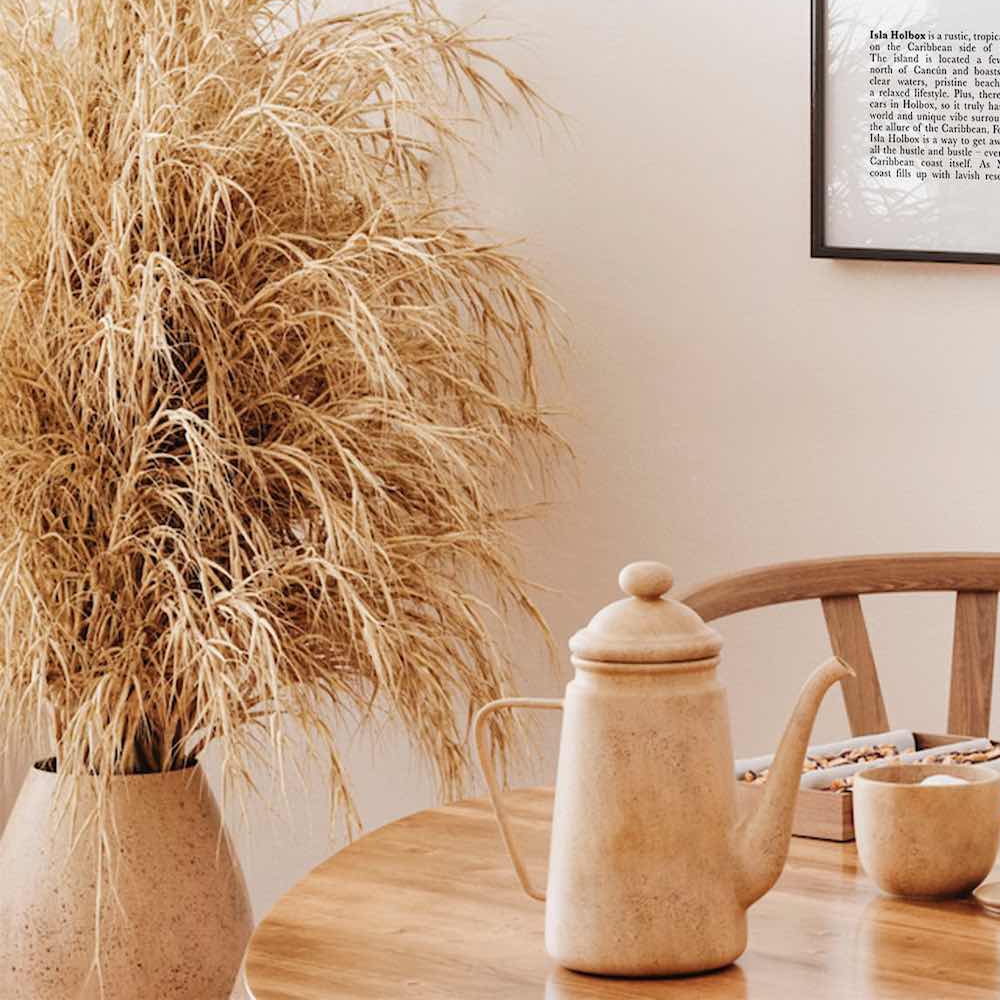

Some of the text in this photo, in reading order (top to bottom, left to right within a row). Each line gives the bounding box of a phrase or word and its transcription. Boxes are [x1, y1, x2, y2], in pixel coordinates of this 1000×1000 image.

[870, 30, 888, 39] Isla
[890, 31, 926, 40] Holbox
[928, 31, 935, 40] is
[944, 31, 972, 42] rustic,
[887, 42, 901, 51] the
[907, 42, 952, 51] Caribbean
[959, 43, 976, 52] side
[983, 43, 992, 52] of
[870, 65, 893, 74] north
[898, 65, 907, 74] of
[913, 66, 947, 74] Cancún
[952, 66, 969, 75] and
[974, 66, 1000, 75] boasts
[869, 76, 890, 85] clear
[897, 78, 930, 87] waters,
[934, 77, 967, 89] pristine
[870, 111, 894, 120] world
[897, 111, 913, 120] and
[916, 112, 946, 123] unique
[950, 112, 968, 121] vibe
[870, 122, 883, 131] the
[886, 122, 910, 132] allure
[912, 123, 921, 132] of
[925, 123, 938, 132] the
[941, 124, 991, 133] Caribbean.
[870, 156, 914, 166] Caribbean
[920, 159, 943, 167] coast
[949, 159, 972, 168] itself.
[979, 160, 990, 168] As
[869, 169, 891, 177] coast
[896, 169, 911, 178] fills
[916, 172, 927, 180] up
[932, 170, 950, 179] with
[955, 170, 980, 180] lavish
